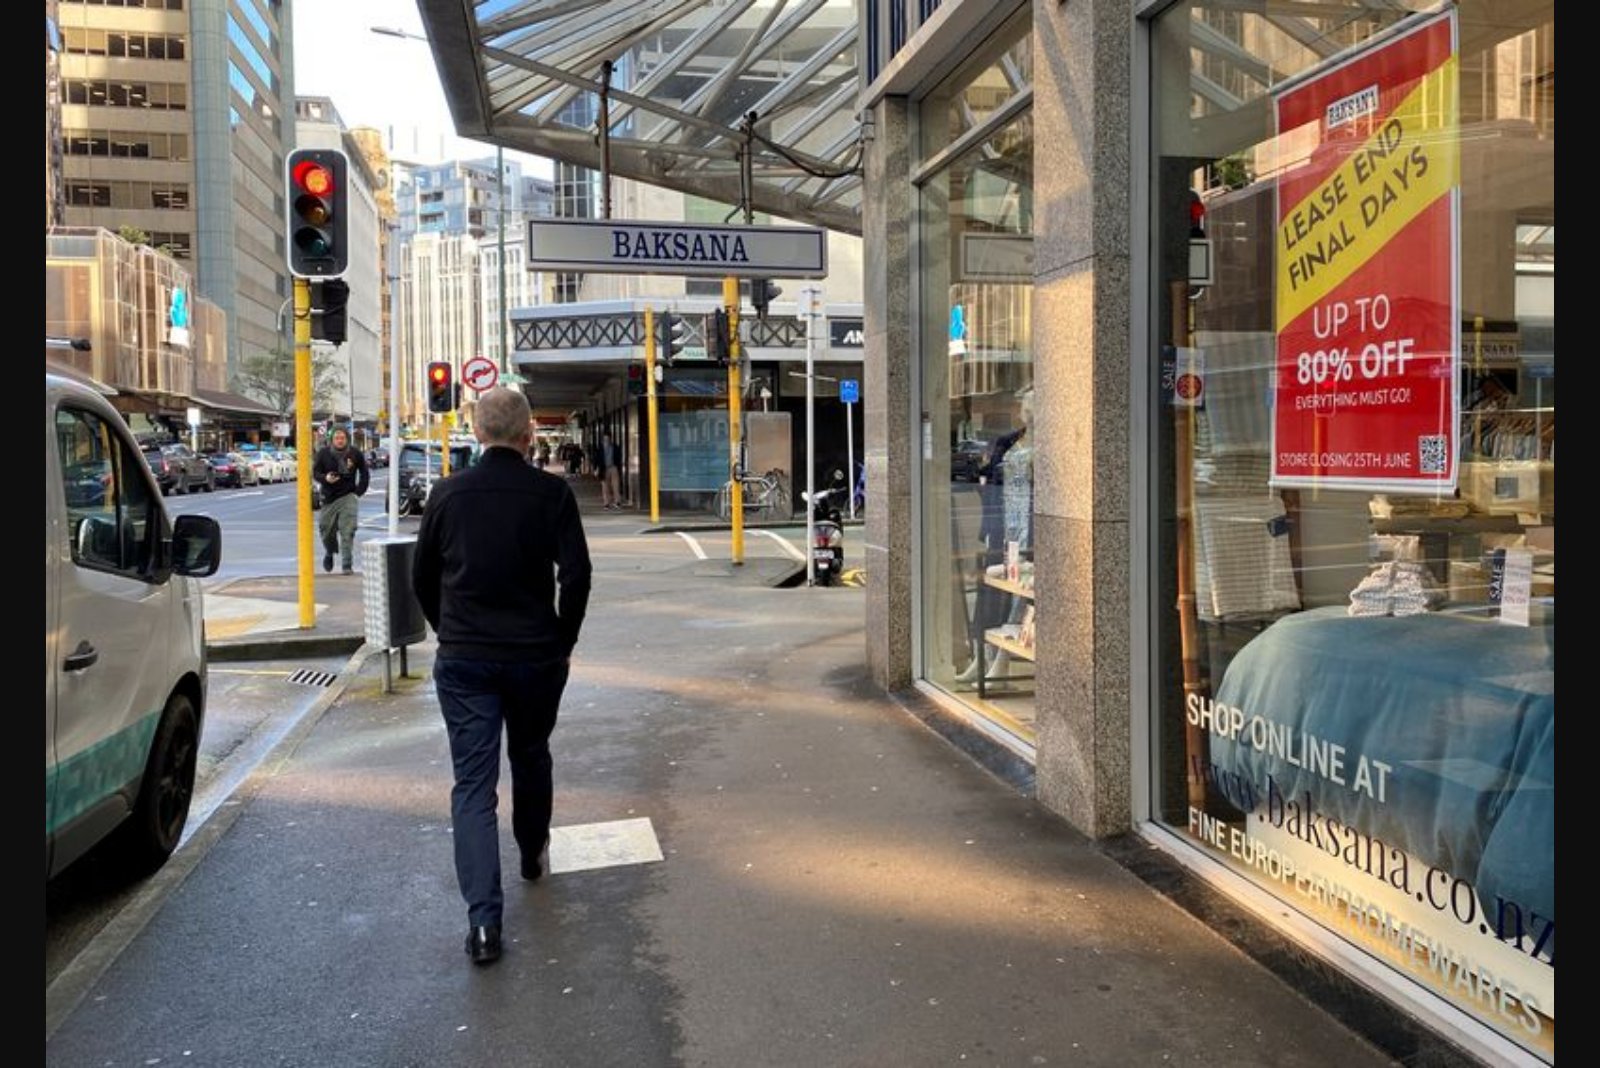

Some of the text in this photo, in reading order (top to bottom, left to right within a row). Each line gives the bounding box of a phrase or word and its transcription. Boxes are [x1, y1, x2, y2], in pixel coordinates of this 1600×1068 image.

[1284, 118, 1403, 250] LEASE END
[1288, 145, 1428, 291] FINAL DAYS
[612, 229, 749, 262] BAKSANA
[1314, 293, 1390, 339] UP TO
[1297, 338, 1415, 385] 80% OFF
[1295, 387, 1412, 410] EVERYTHING MUST GO!
[1279, 452, 1412, 468] STORE CLOSING 25TH JUNE
[1489, 564, 1503, 600] SALE
[1186, 692, 1393, 803] SHOP ONLINE AT
[1188, 806, 1543, 1036] FINE EUROPEAN HOMEWARES
